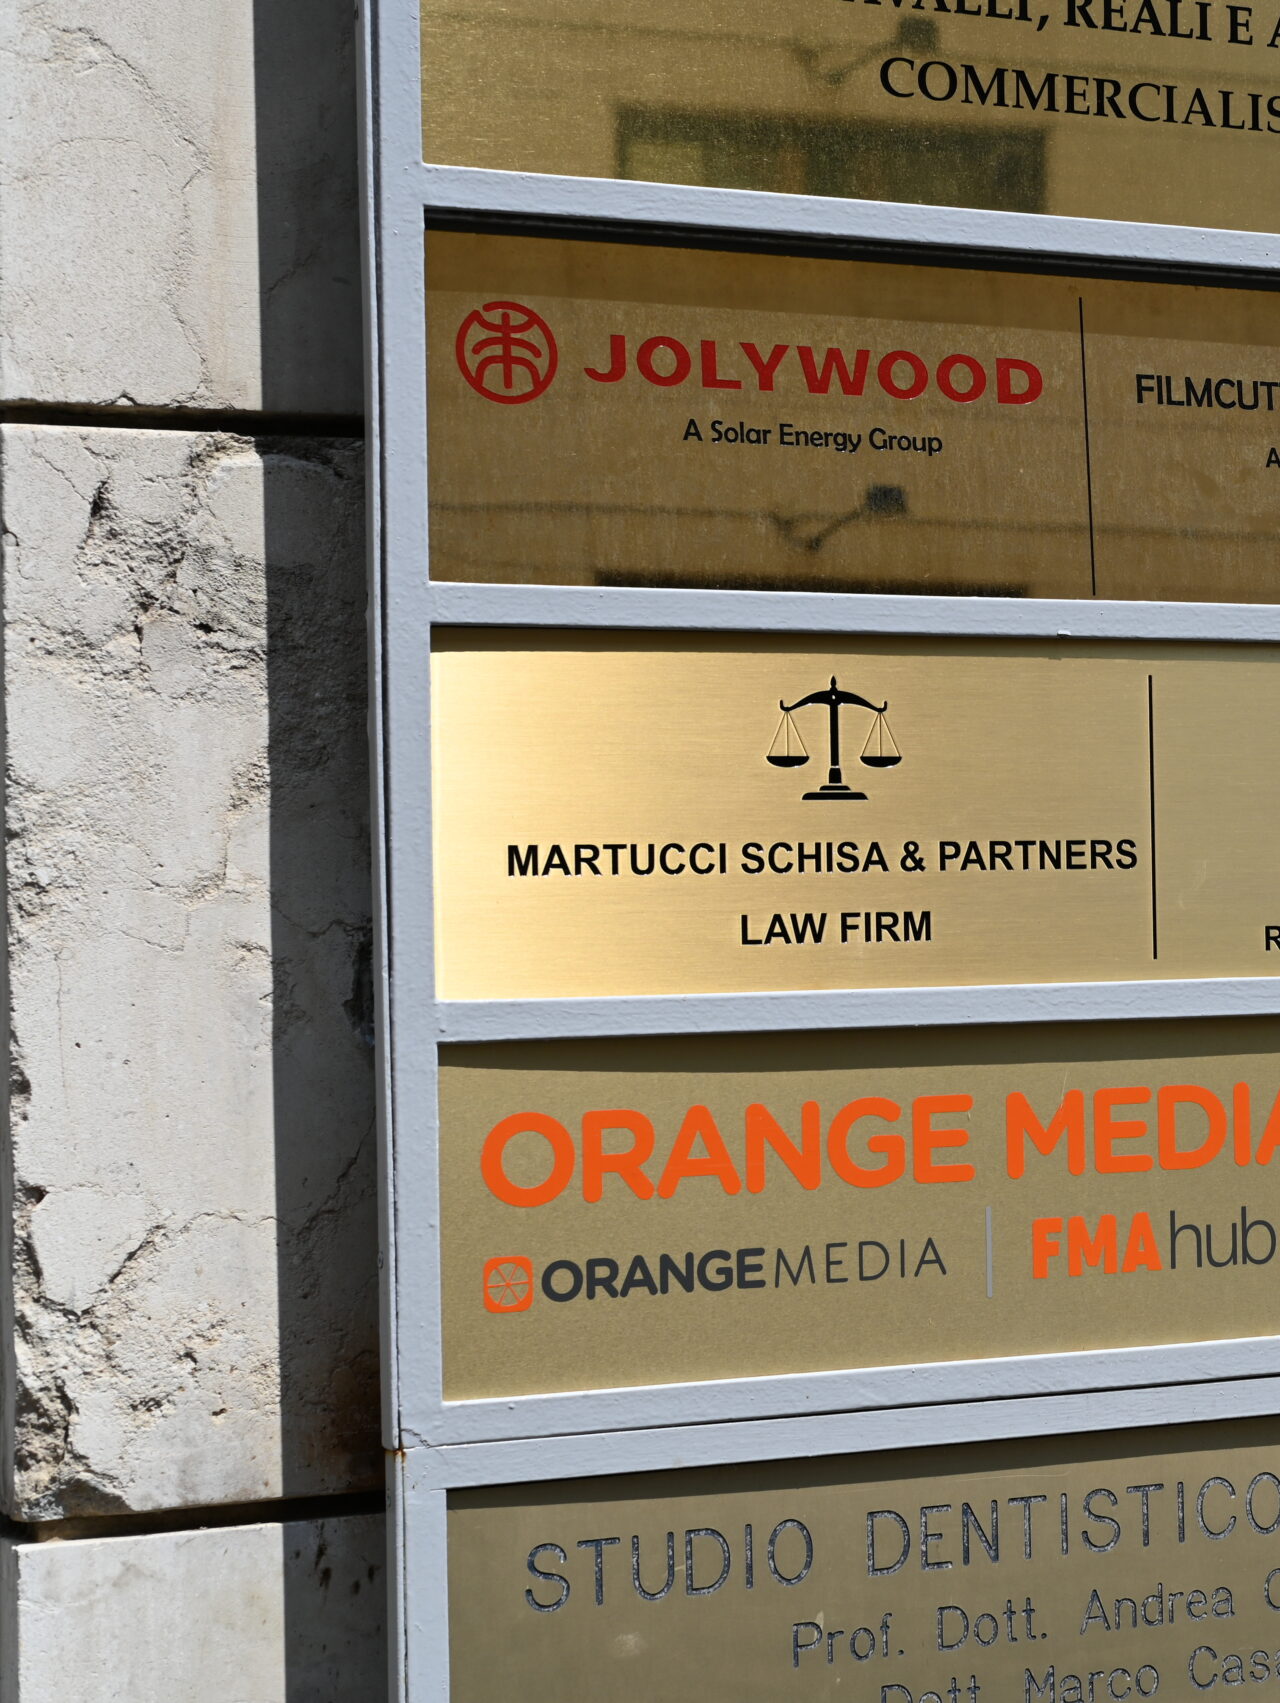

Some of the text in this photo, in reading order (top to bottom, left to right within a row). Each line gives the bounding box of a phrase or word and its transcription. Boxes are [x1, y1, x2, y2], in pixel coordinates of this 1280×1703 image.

[1064, 0, 1212, 41] REALI
[1226, 5, 1253, 45] E
[585, 335, 1043, 404] JOLYWOOD
[683, 419, 942, 456] A Solar Energy Group
[508, 839, 1137, 876] MARTUCCI SCHISA & PARTNERS
[741, 911, 931, 945] LAW FIRM
[481, 1094, 975, 1207] ORANGE
[524, 1519, 814, 1612] STUDIO
[793, 1613, 904, 1667] Prof.
[938, 1597, 1047, 1649] Dott.
[1080, 1583, 1236, 1635] Andrea
[1025, 1665, 1159, 1703] Marco
